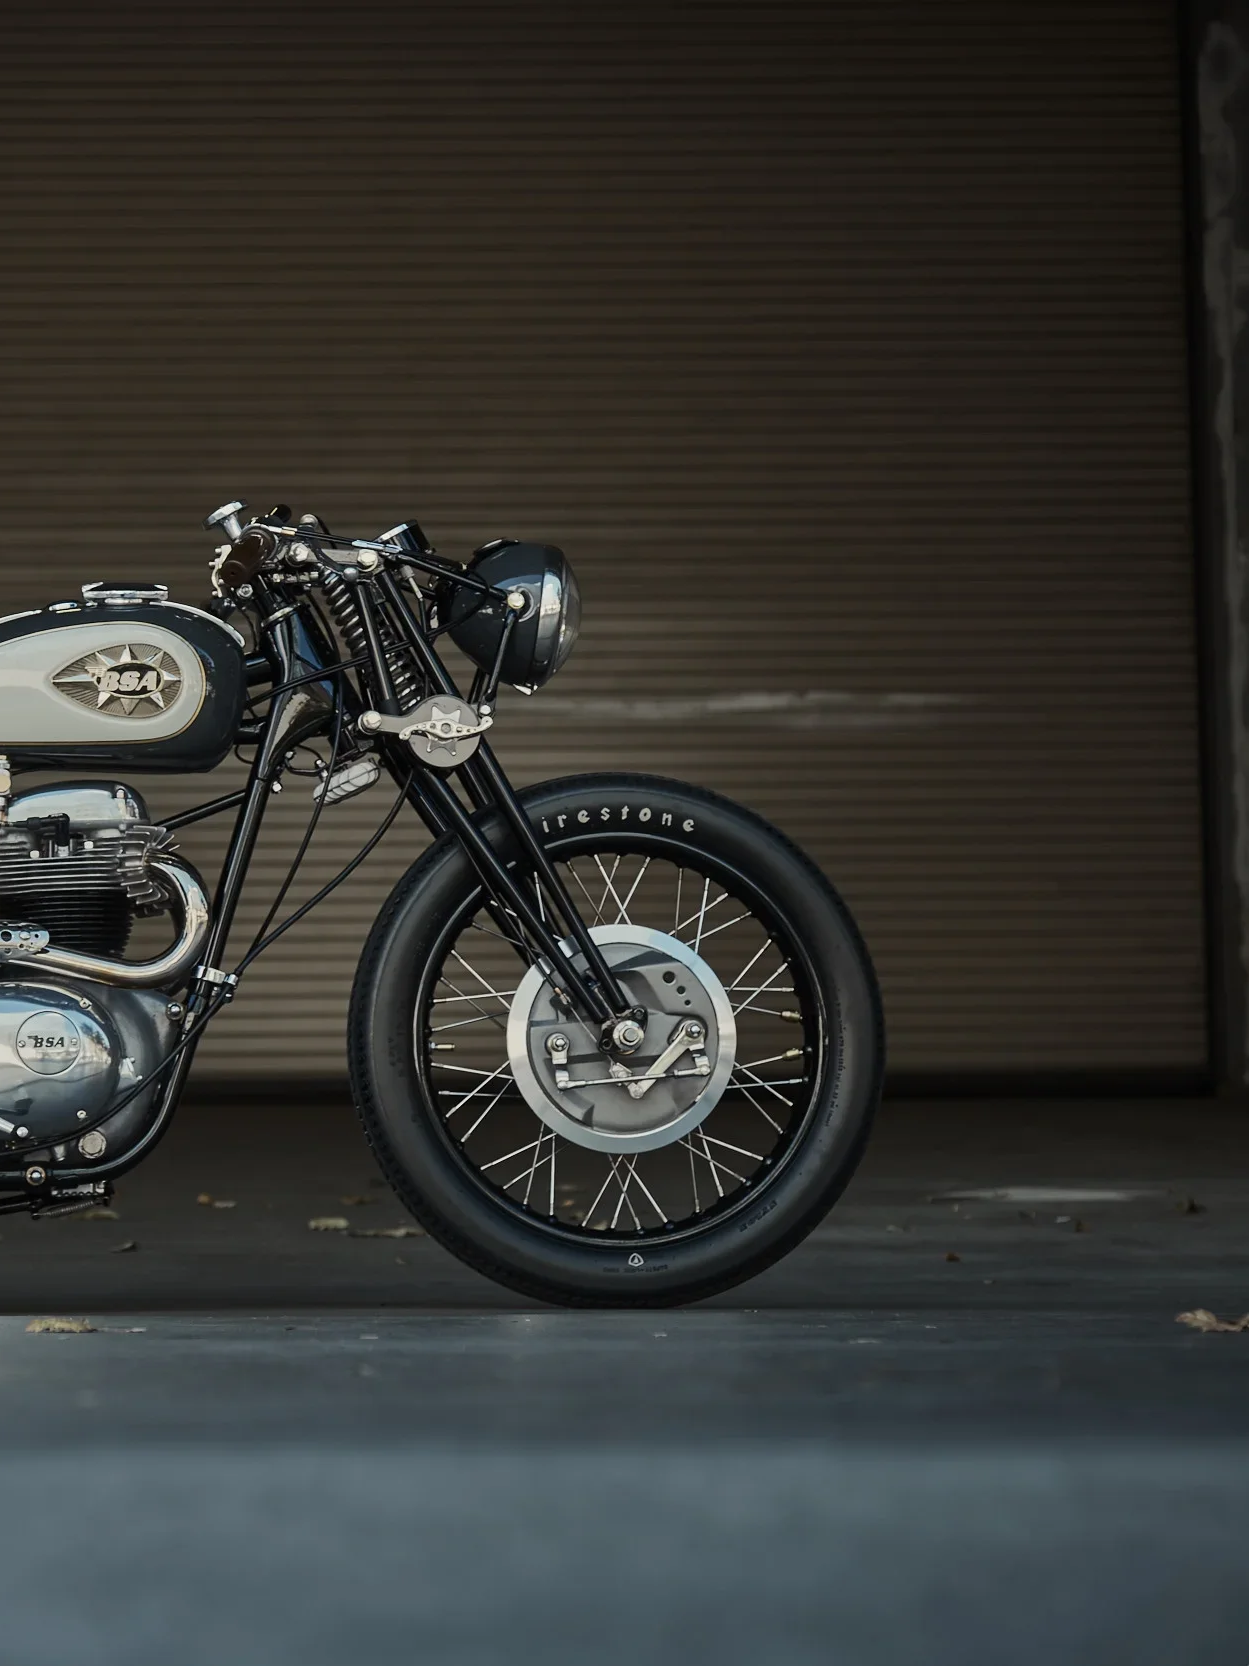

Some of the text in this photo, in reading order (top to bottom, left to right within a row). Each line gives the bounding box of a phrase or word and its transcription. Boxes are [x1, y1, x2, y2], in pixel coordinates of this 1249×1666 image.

[96, 670, 158, 692] BSA
[541, 805, 695, 833] irestone
[32, 1036, 65, 1048] BSA
